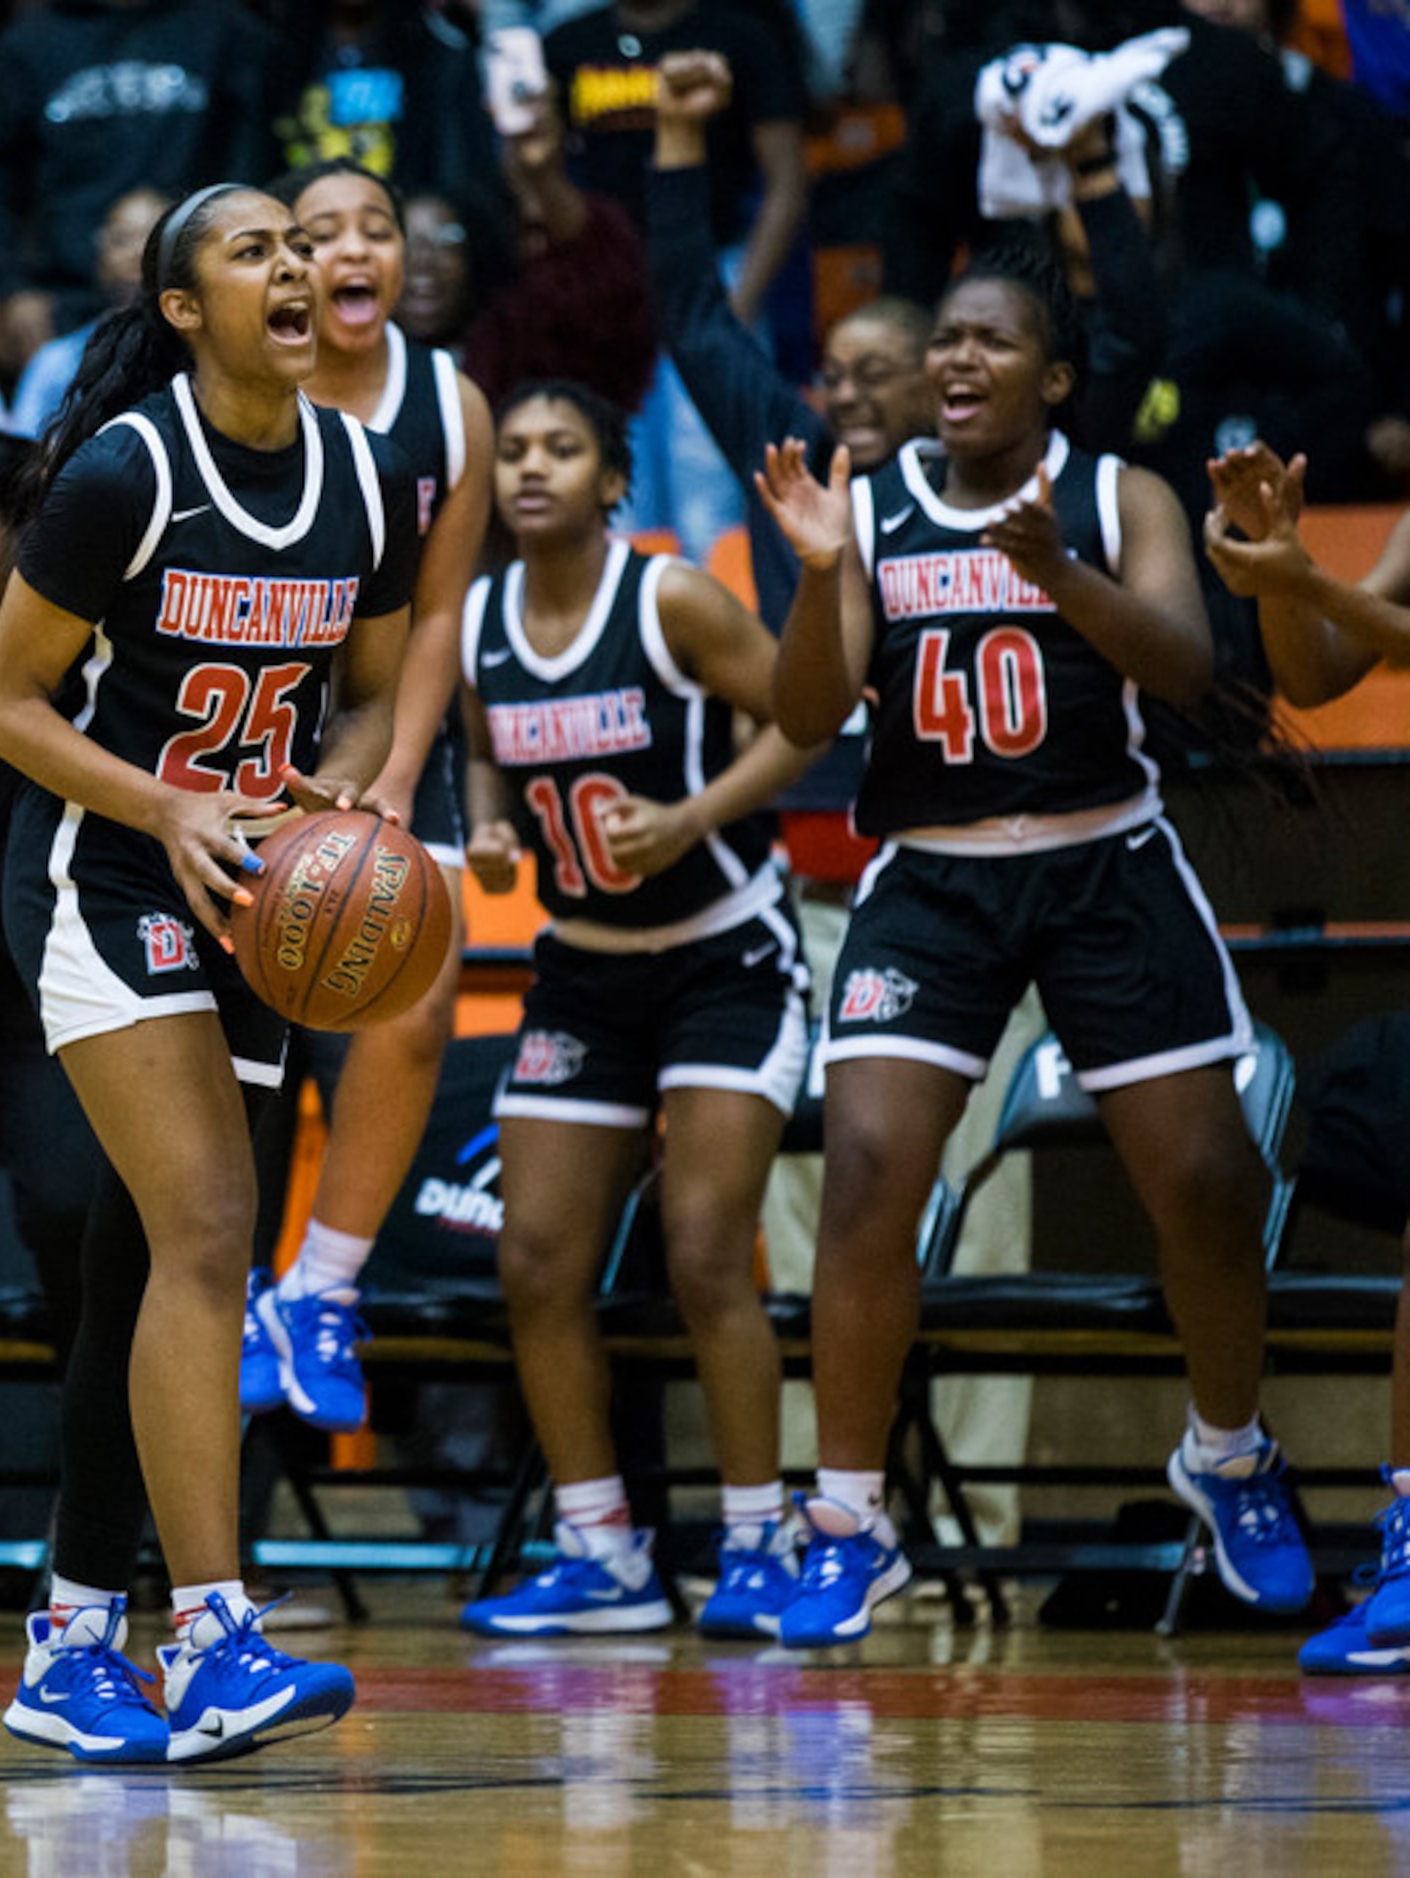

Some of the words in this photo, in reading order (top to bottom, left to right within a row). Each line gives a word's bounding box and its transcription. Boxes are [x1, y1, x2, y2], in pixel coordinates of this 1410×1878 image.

[156, 663, 312, 800] 25
[913, 628, 1048, 763] 40
[526, 772, 643, 897] 10
[322, 845, 409, 997] SPALDING
